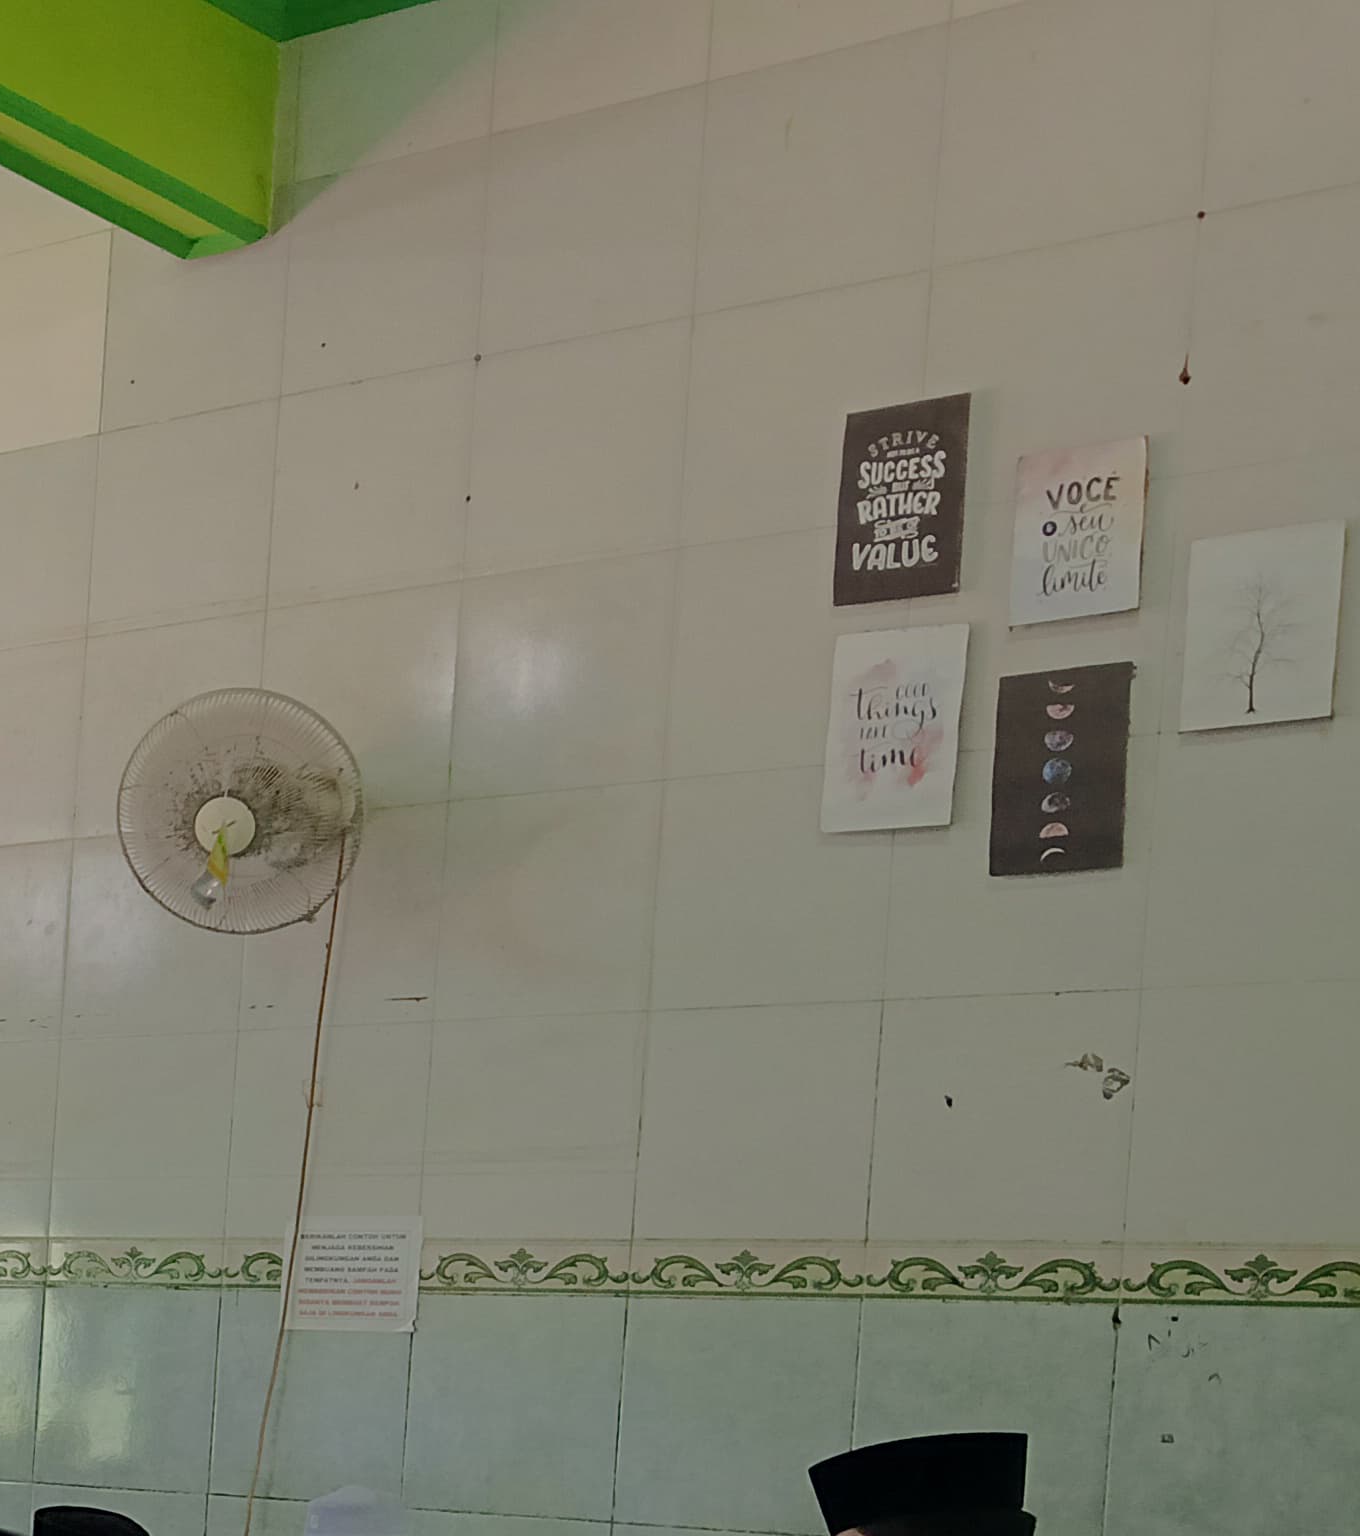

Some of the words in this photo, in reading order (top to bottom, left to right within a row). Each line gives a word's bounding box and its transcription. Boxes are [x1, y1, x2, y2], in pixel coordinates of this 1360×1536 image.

[867, 430, 940, 458] STRIVE
[857, 450, 947, 489] SUCCESS
[856, 491, 941, 525] RATHER
[851, 534, 939, 571] VALUE
